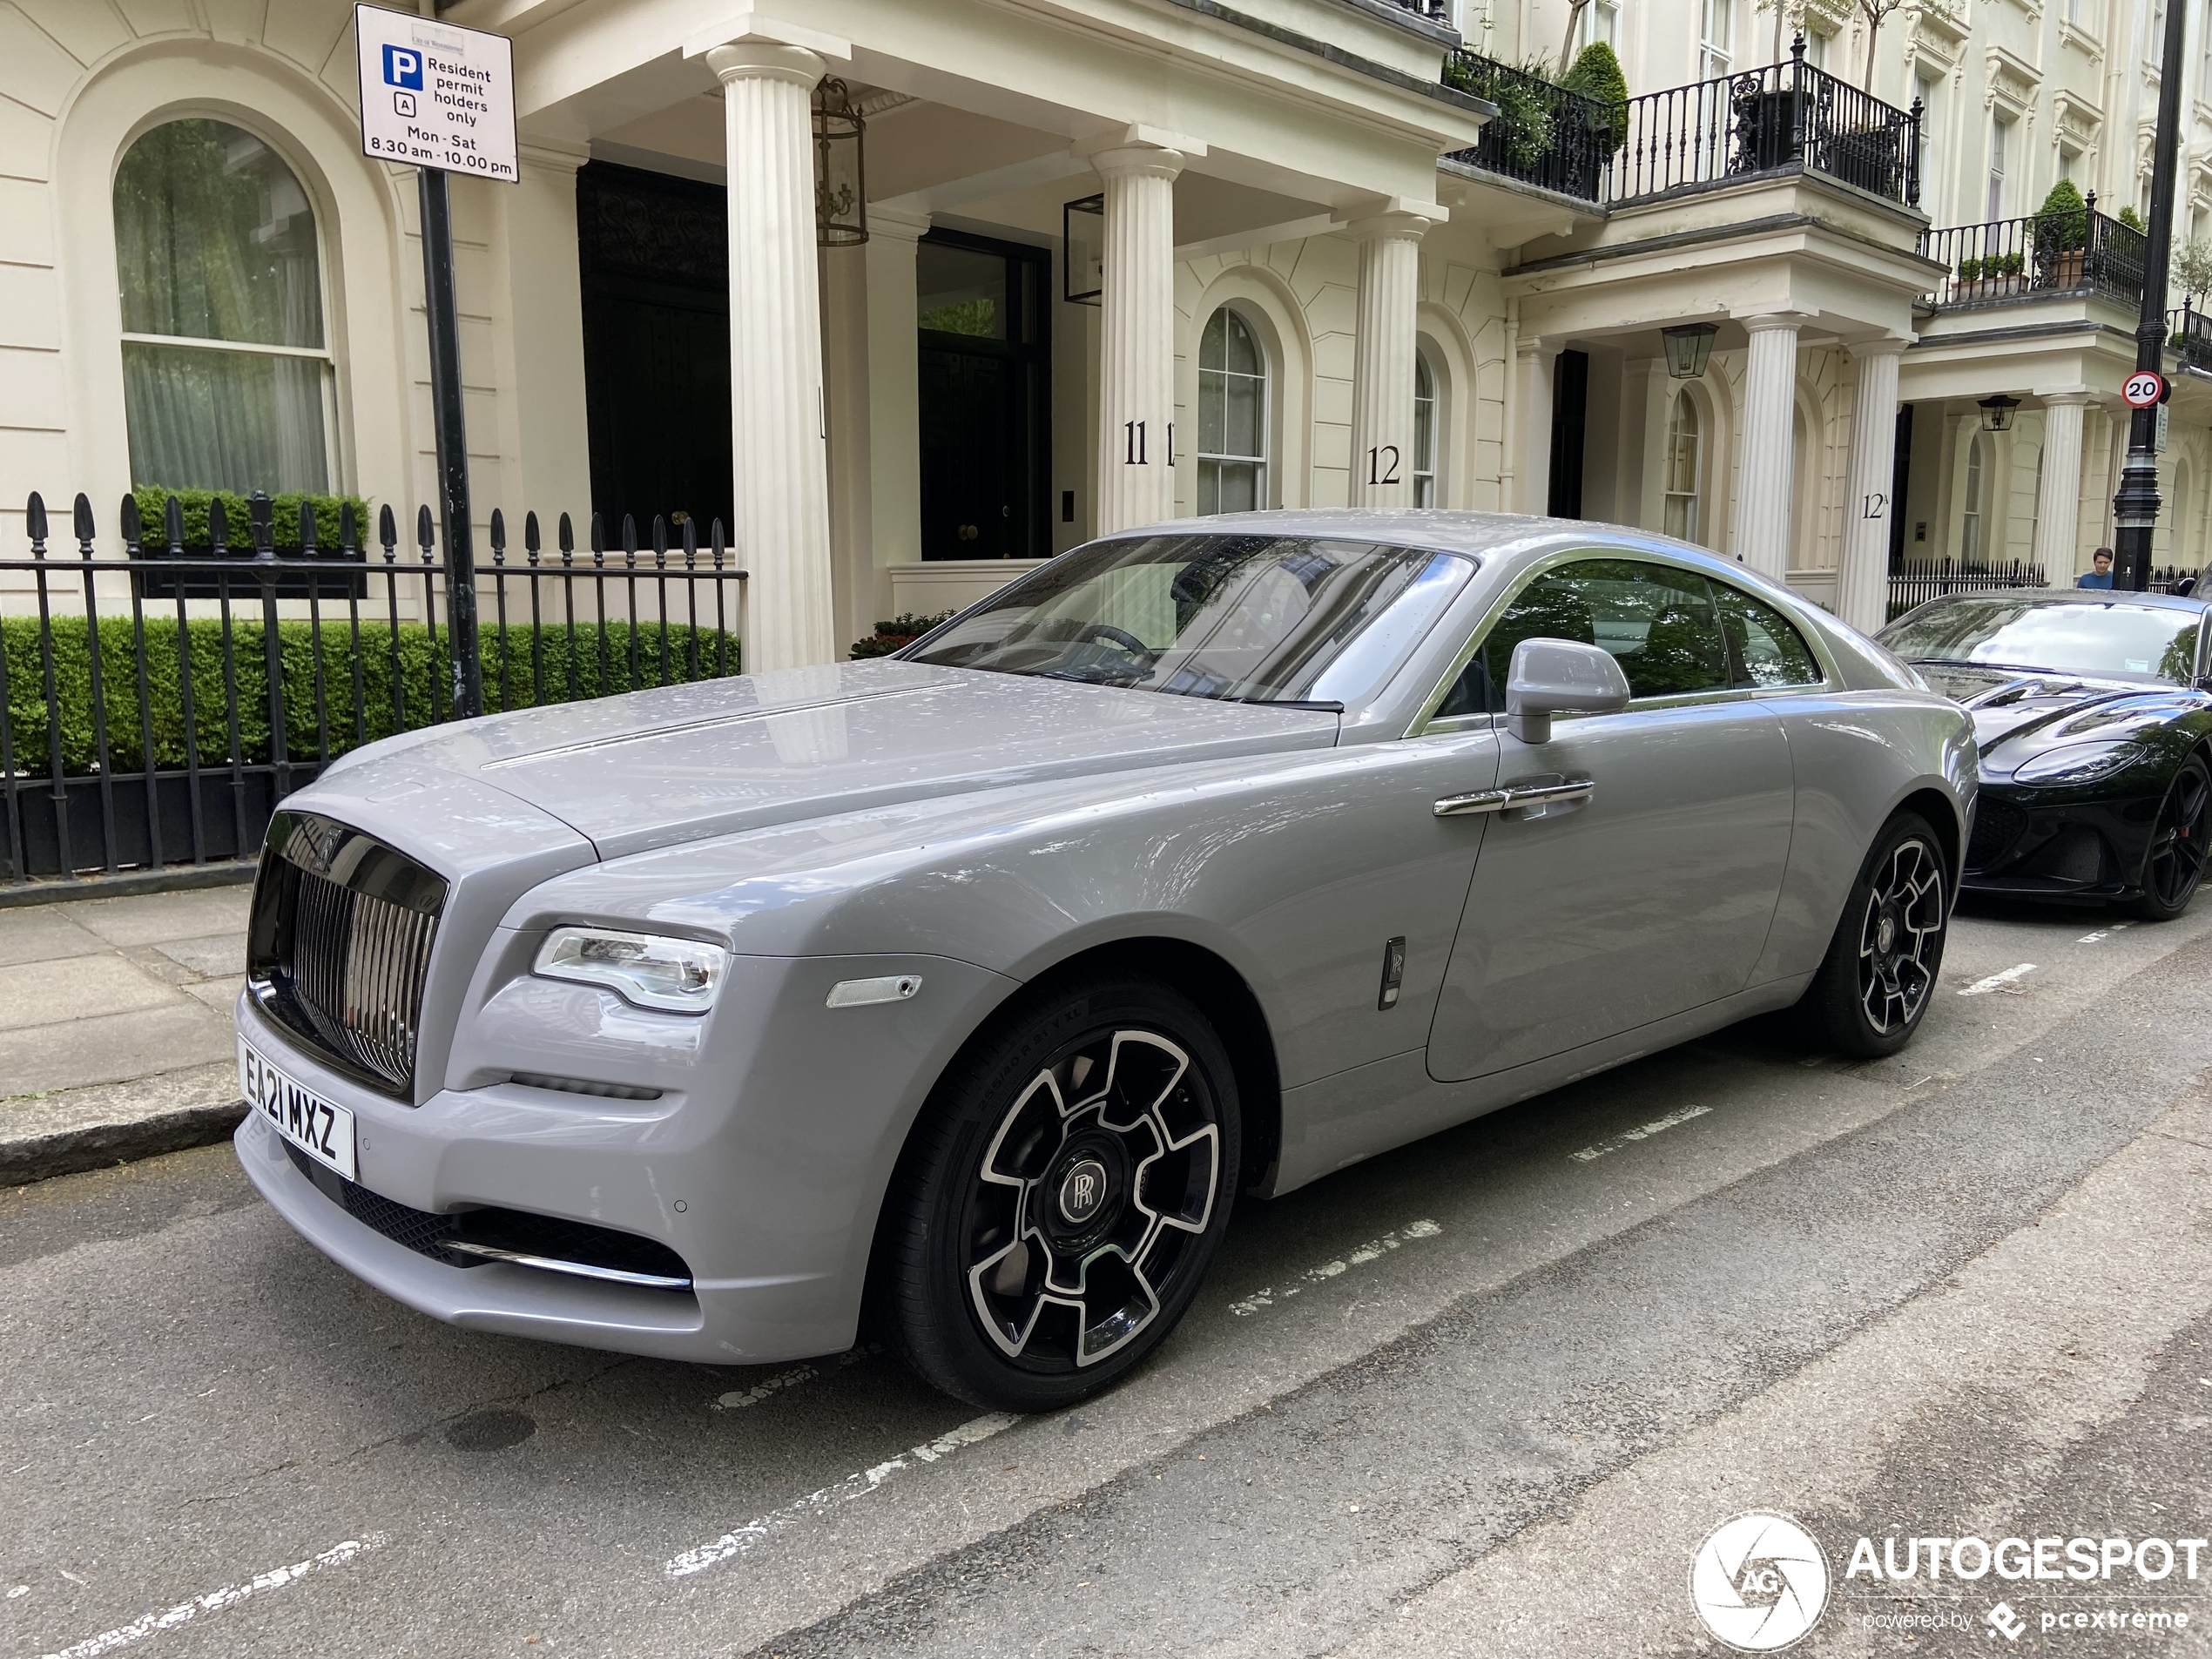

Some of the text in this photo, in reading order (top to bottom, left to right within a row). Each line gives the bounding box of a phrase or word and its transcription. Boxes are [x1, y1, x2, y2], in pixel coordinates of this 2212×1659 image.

[392, 51, 416, 84] P
[428, 57, 491, 82] Resident
[437, 78, 483, 96] permit
[401, 99, 409, 110] A
[435, 91, 488, 112] holders
[448, 111, 476, 127] only
[408, 125, 439, 143] Mon
[452, 135, 476, 150] Sat
[371, 138, 408, 154] 8.30
[411, 147, 433, 159] am
[445, 151, 487, 169] 10.00
[491, 162, 512, 174] pm
[2128, 381, 2157, 397] 20
[1124, 420, 1148, 464] 11
[1368, 445, 1400, 485] 12
[246, 1048, 335, 1160] EA21 MXZ
